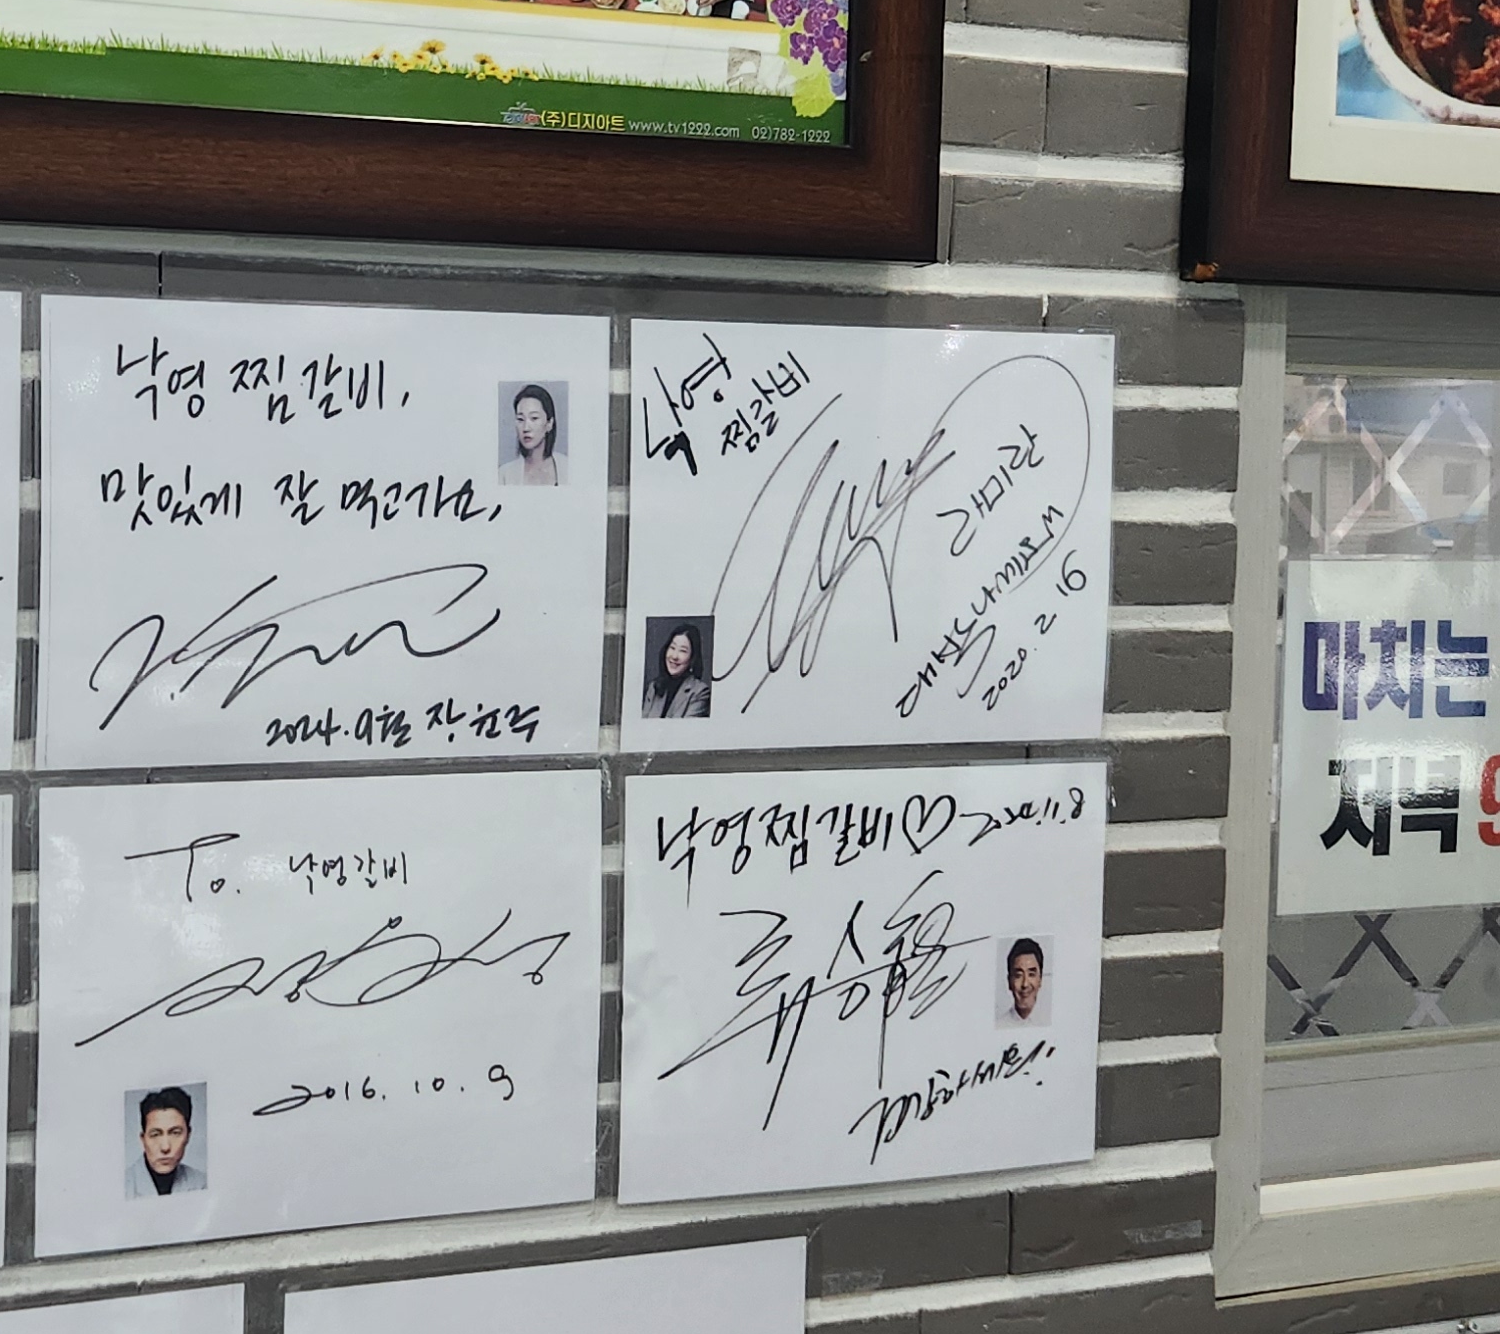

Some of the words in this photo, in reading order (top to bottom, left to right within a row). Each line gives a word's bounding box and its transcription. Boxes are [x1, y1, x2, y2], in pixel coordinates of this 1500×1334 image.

[628, 118, 741, 140] www.tv1222.com
[274, 469, 325, 526] 잘
[1301, 617, 1490, 721] 마치는
